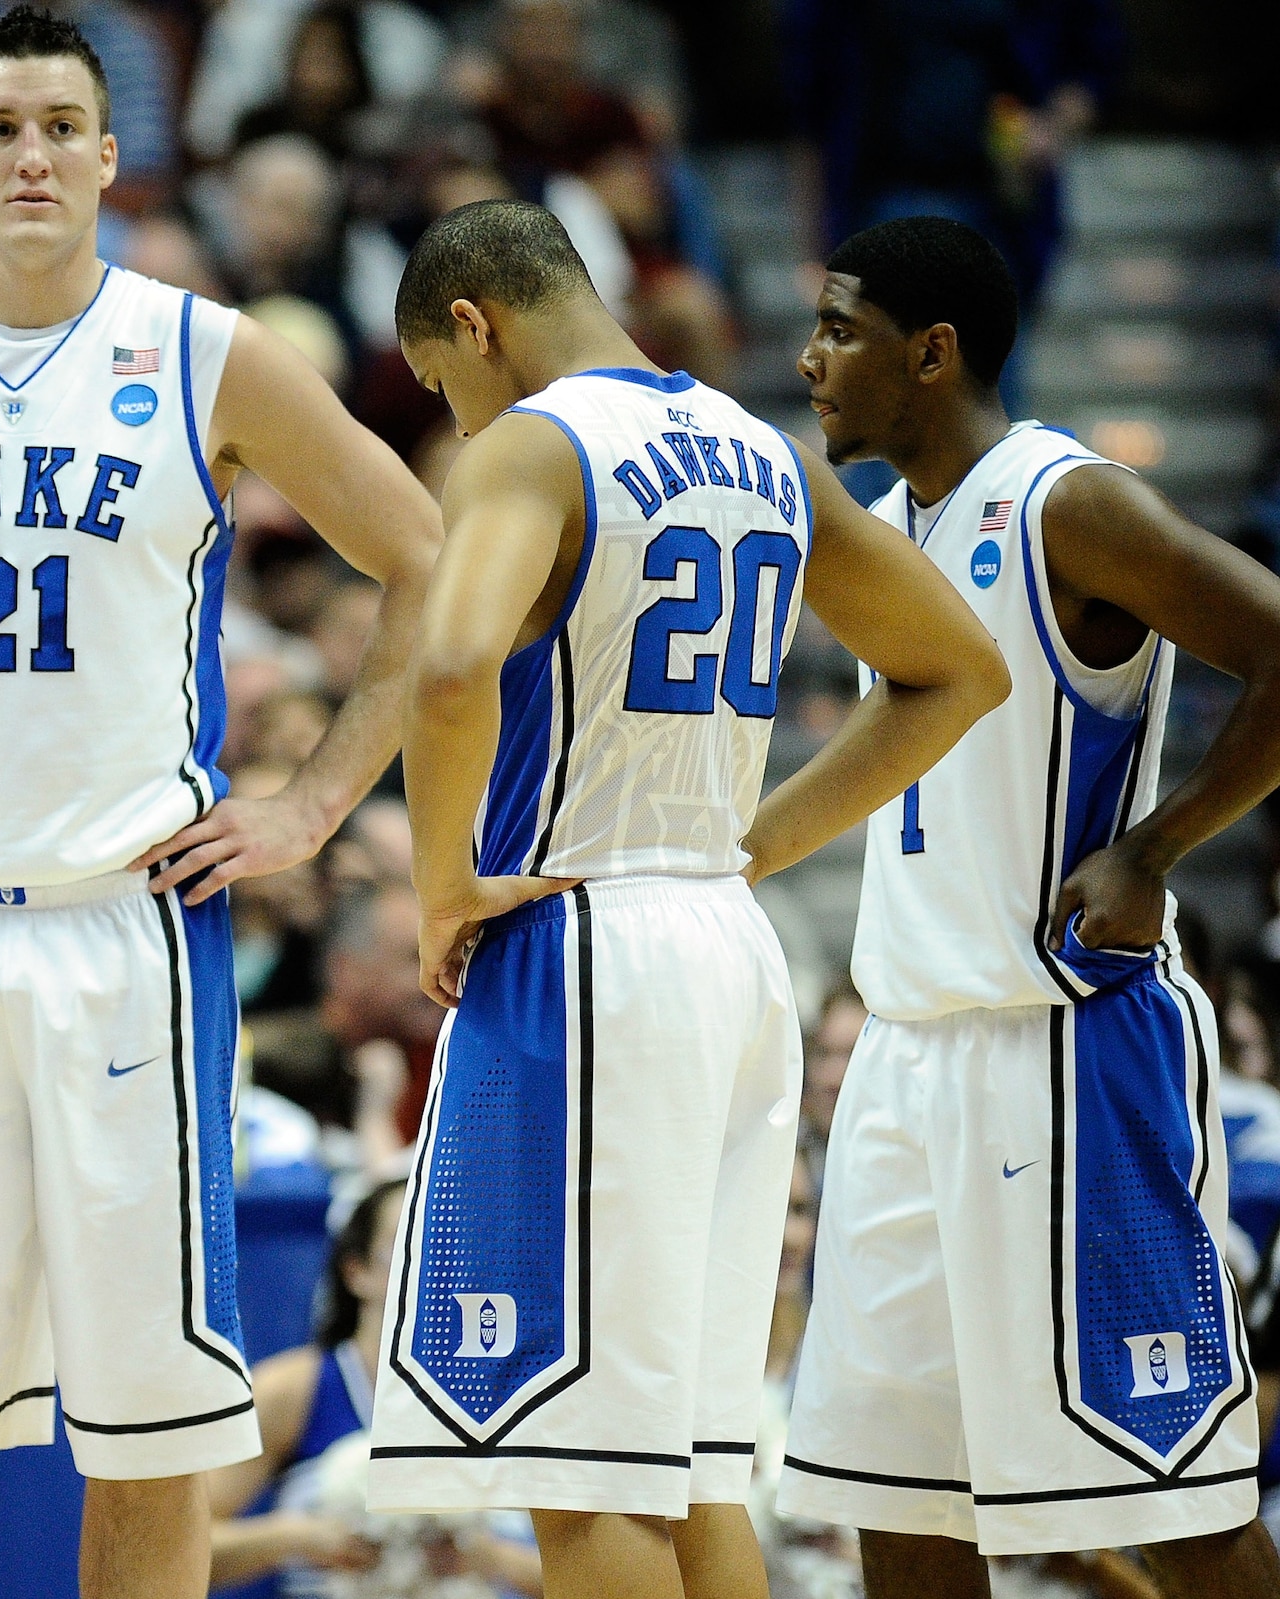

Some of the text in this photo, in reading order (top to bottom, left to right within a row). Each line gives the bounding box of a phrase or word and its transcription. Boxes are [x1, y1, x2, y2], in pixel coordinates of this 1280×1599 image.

[116, 401, 154, 414] NCAA
[666, 407, 702, 431] ACC
[613, 431, 797, 526] DAWKINS
[973, 563, 998, 577] NCAA
[622, 524, 802, 720] 20
